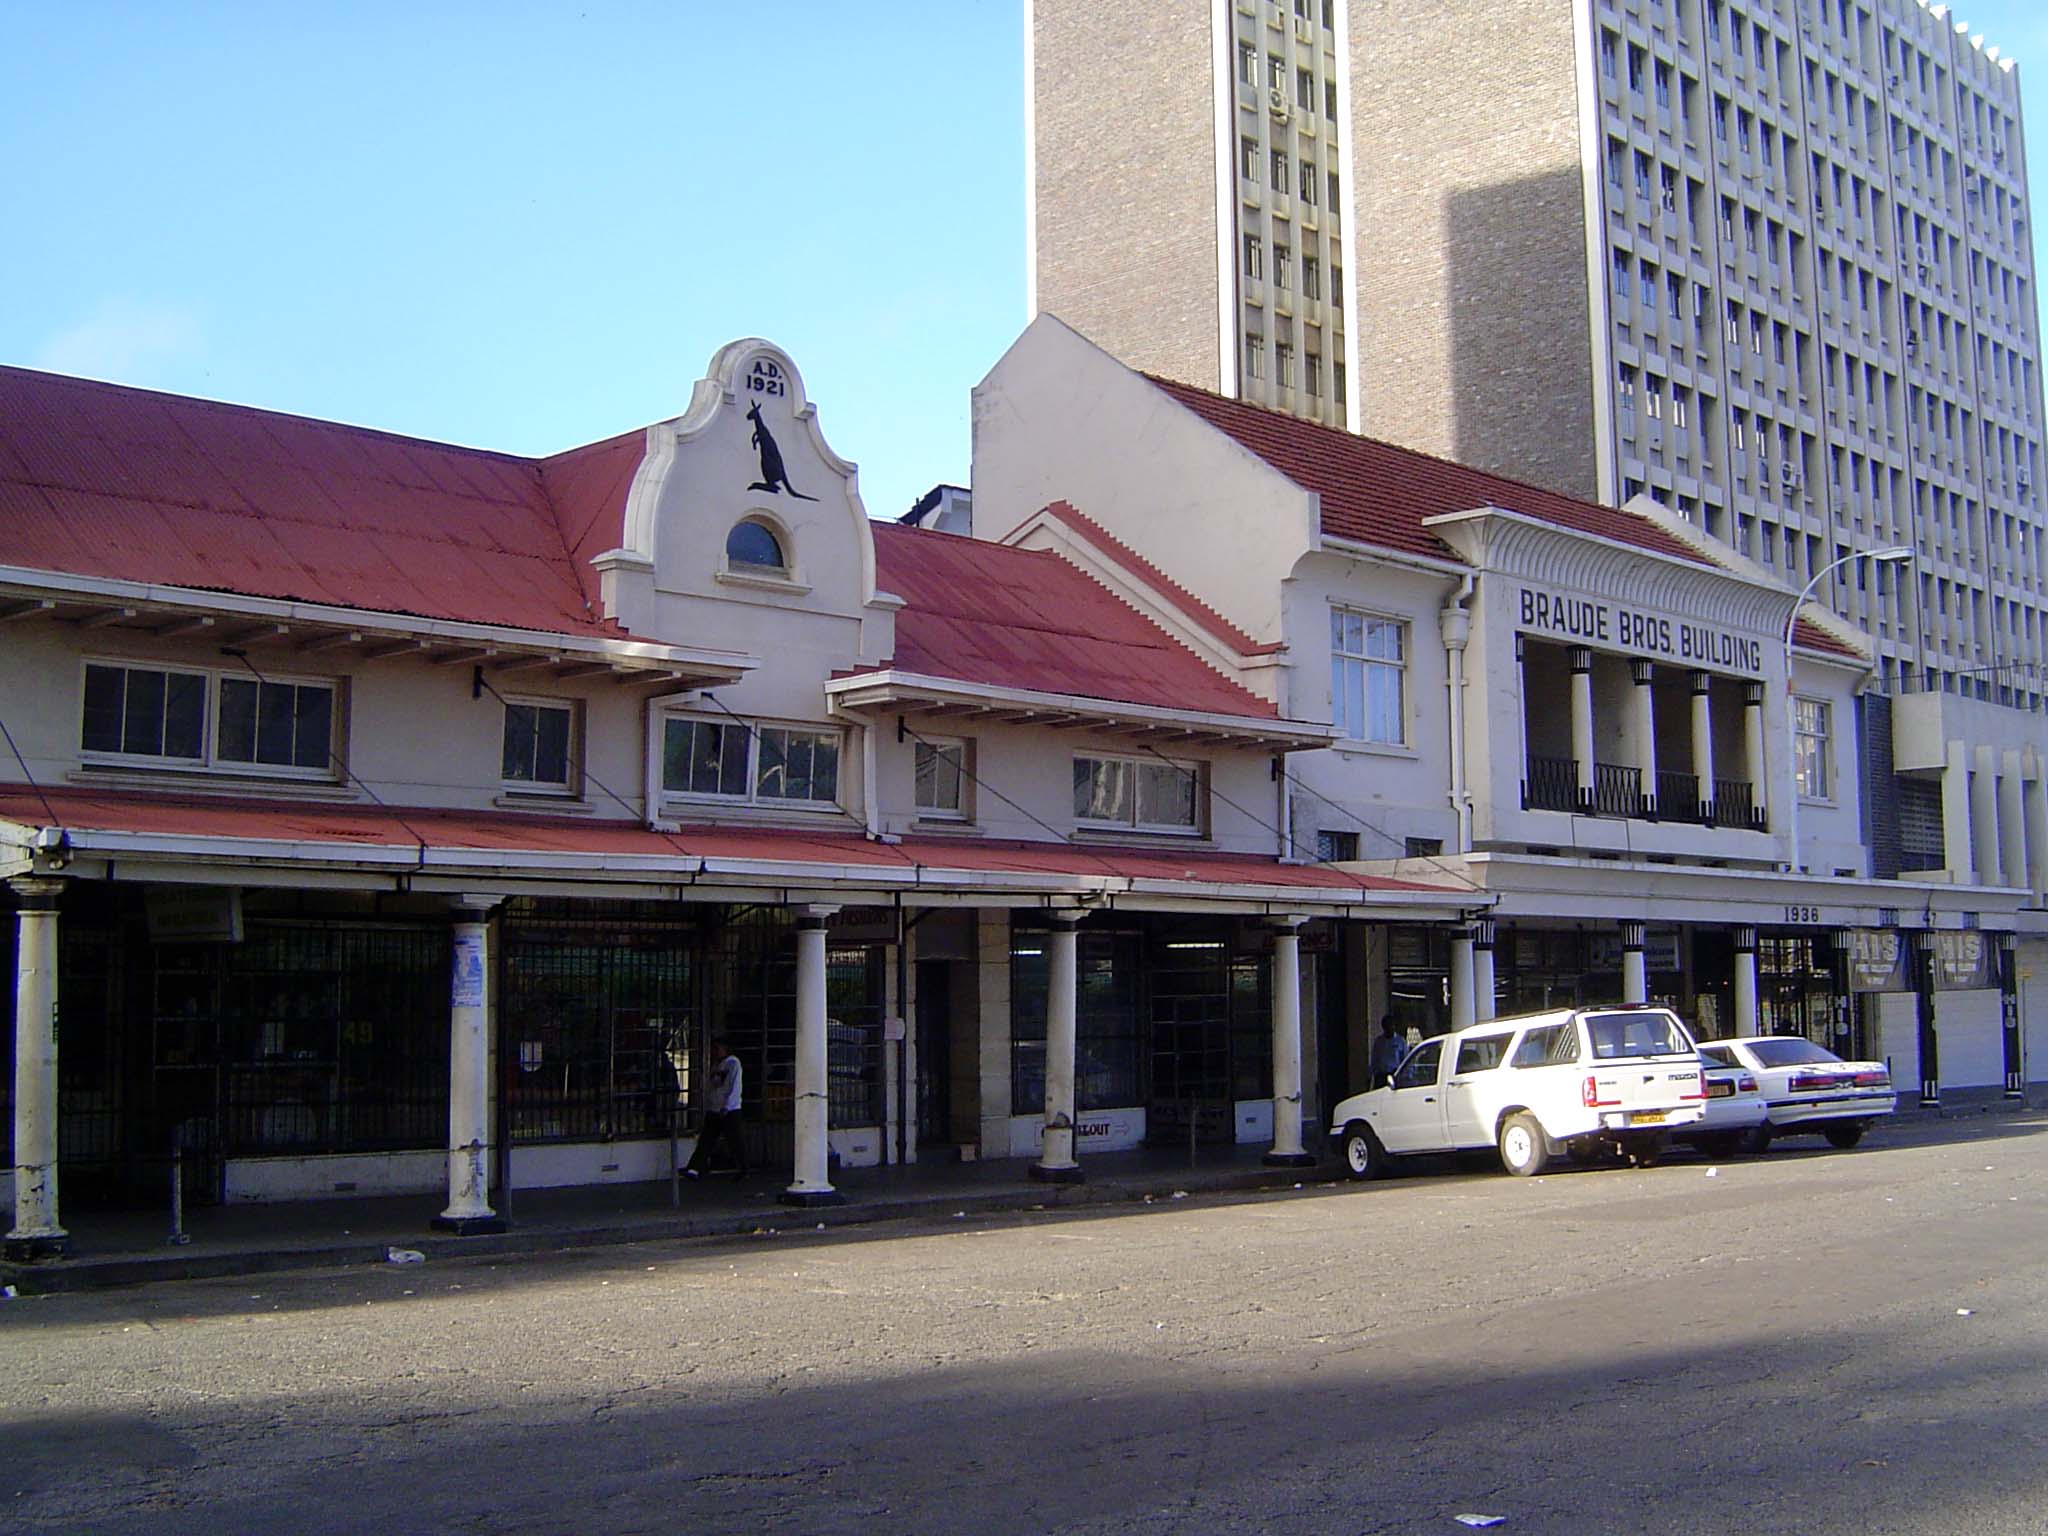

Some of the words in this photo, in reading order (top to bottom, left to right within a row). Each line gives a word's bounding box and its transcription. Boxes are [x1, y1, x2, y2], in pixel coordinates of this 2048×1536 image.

[753, 361, 782, 379] A.D.
[746, 375, 784, 396] 1921
[1520, 588, 1609, 640] BRAUDE
[1620, 611, 1675, 655] BROS.
[1681, 624, 1760, 671] BUILDING
